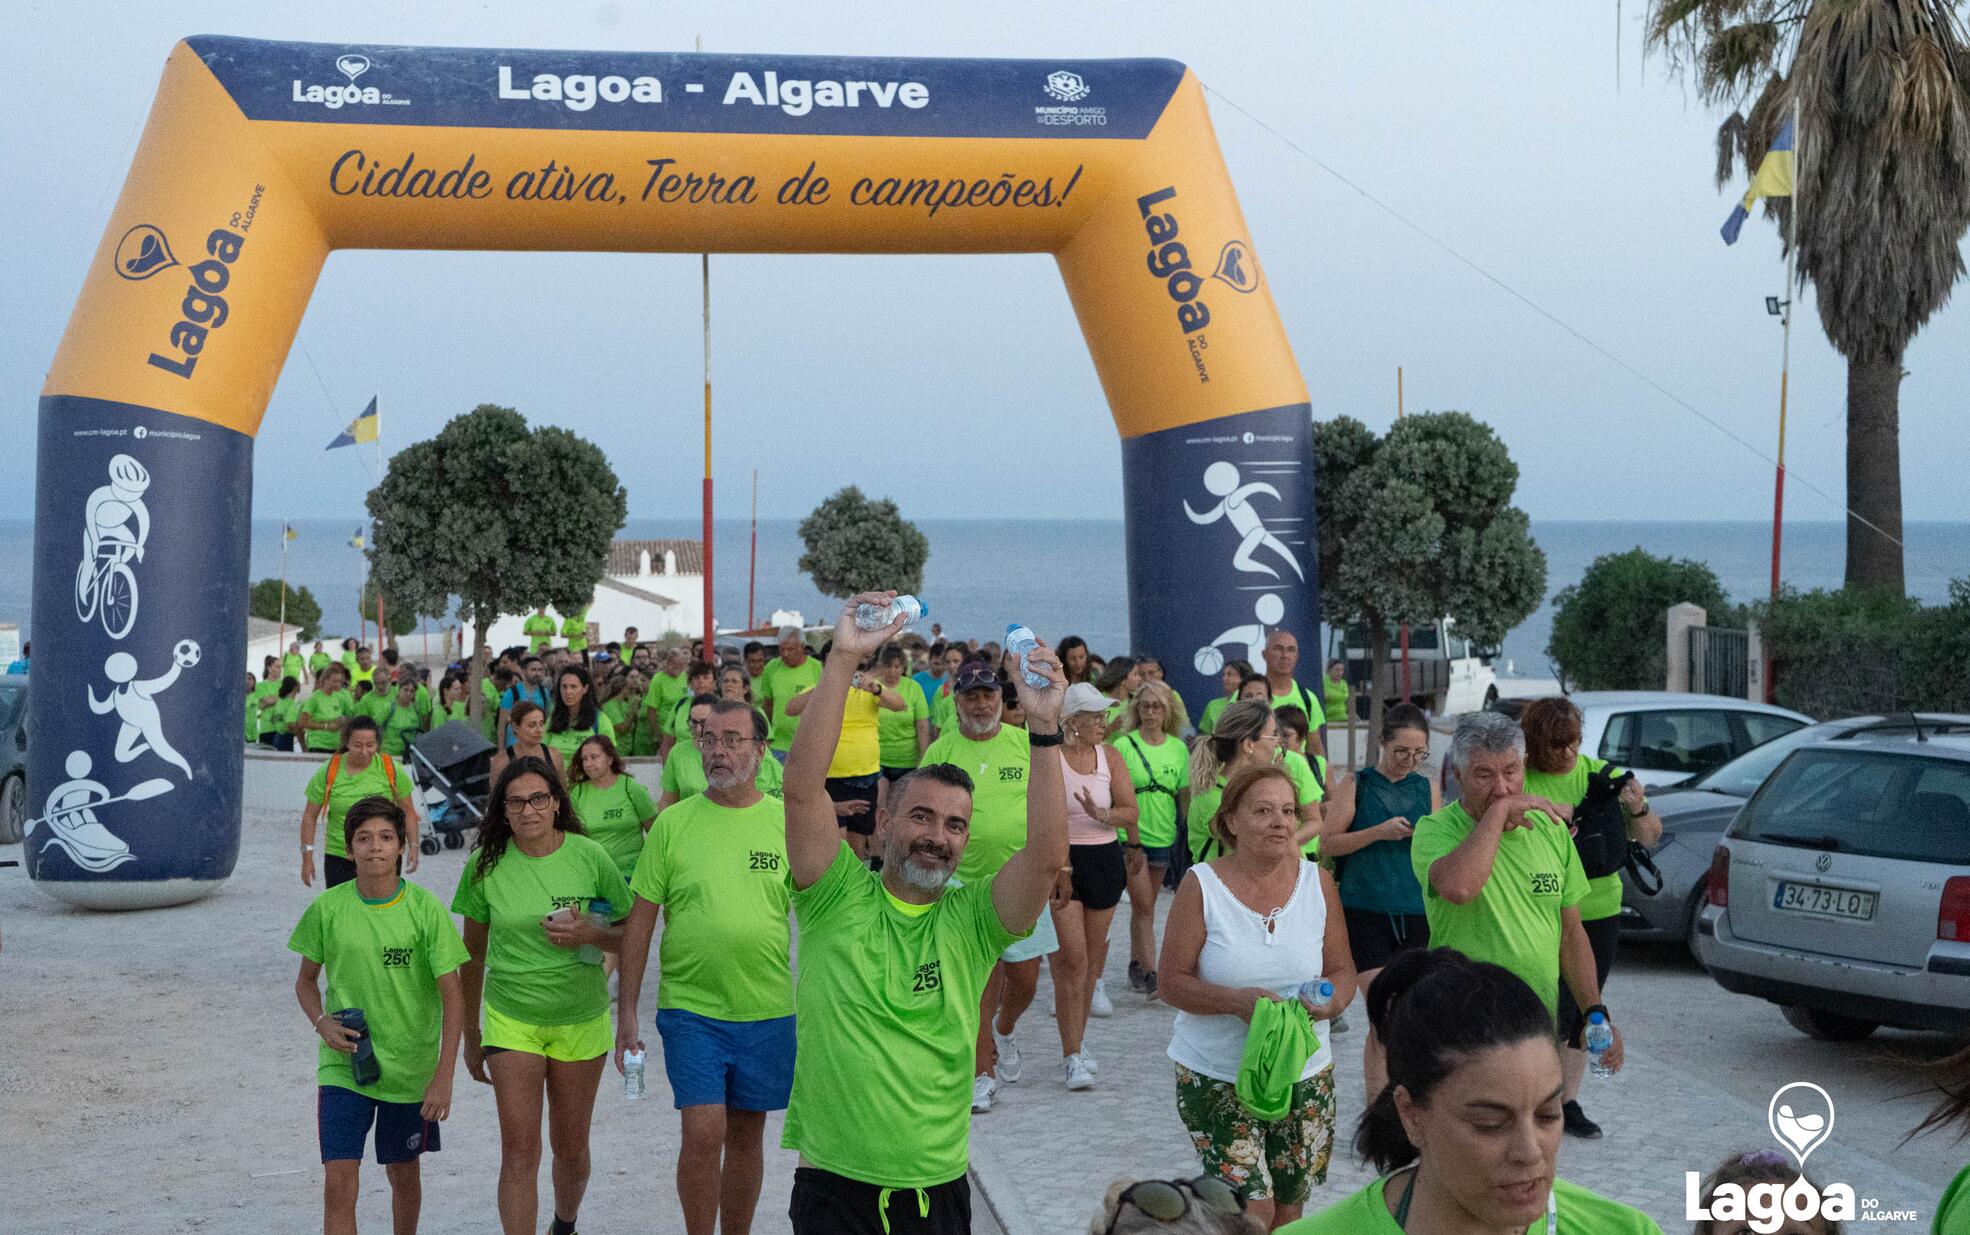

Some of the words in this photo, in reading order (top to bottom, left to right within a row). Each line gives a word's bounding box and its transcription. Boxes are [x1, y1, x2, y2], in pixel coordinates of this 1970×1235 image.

[293, 80, 381, 109] Lagoa
[499, 66, 662, 111] Lagoa
[686, 83, 704, 93] -
[722, 72, 930, 116] Algarve
[330, 149, 493, 200] Cidade
[505, 160, 626, 205] ativa,
[641, 158, 758, 204] Terra
[777, 161, 831, 205] de
[850, 164, 1083, 218] campeões!
[229, 212, 242, 228] DO
[241, 184, 265, 232] ALGARVE
[1137, 186, 1210, 335] Lagoa
[147, 229, 245, 379] Lagoa
[1197, 334, 1208, 350] DO
[1188, 339, 1210, 384] ALGARVE
[999, 770, 1022, 780] 250
[749, 857, 778, 870] 250
[1532, 879, 1560, 893] 250
[383, 953, 411, 966] 250
